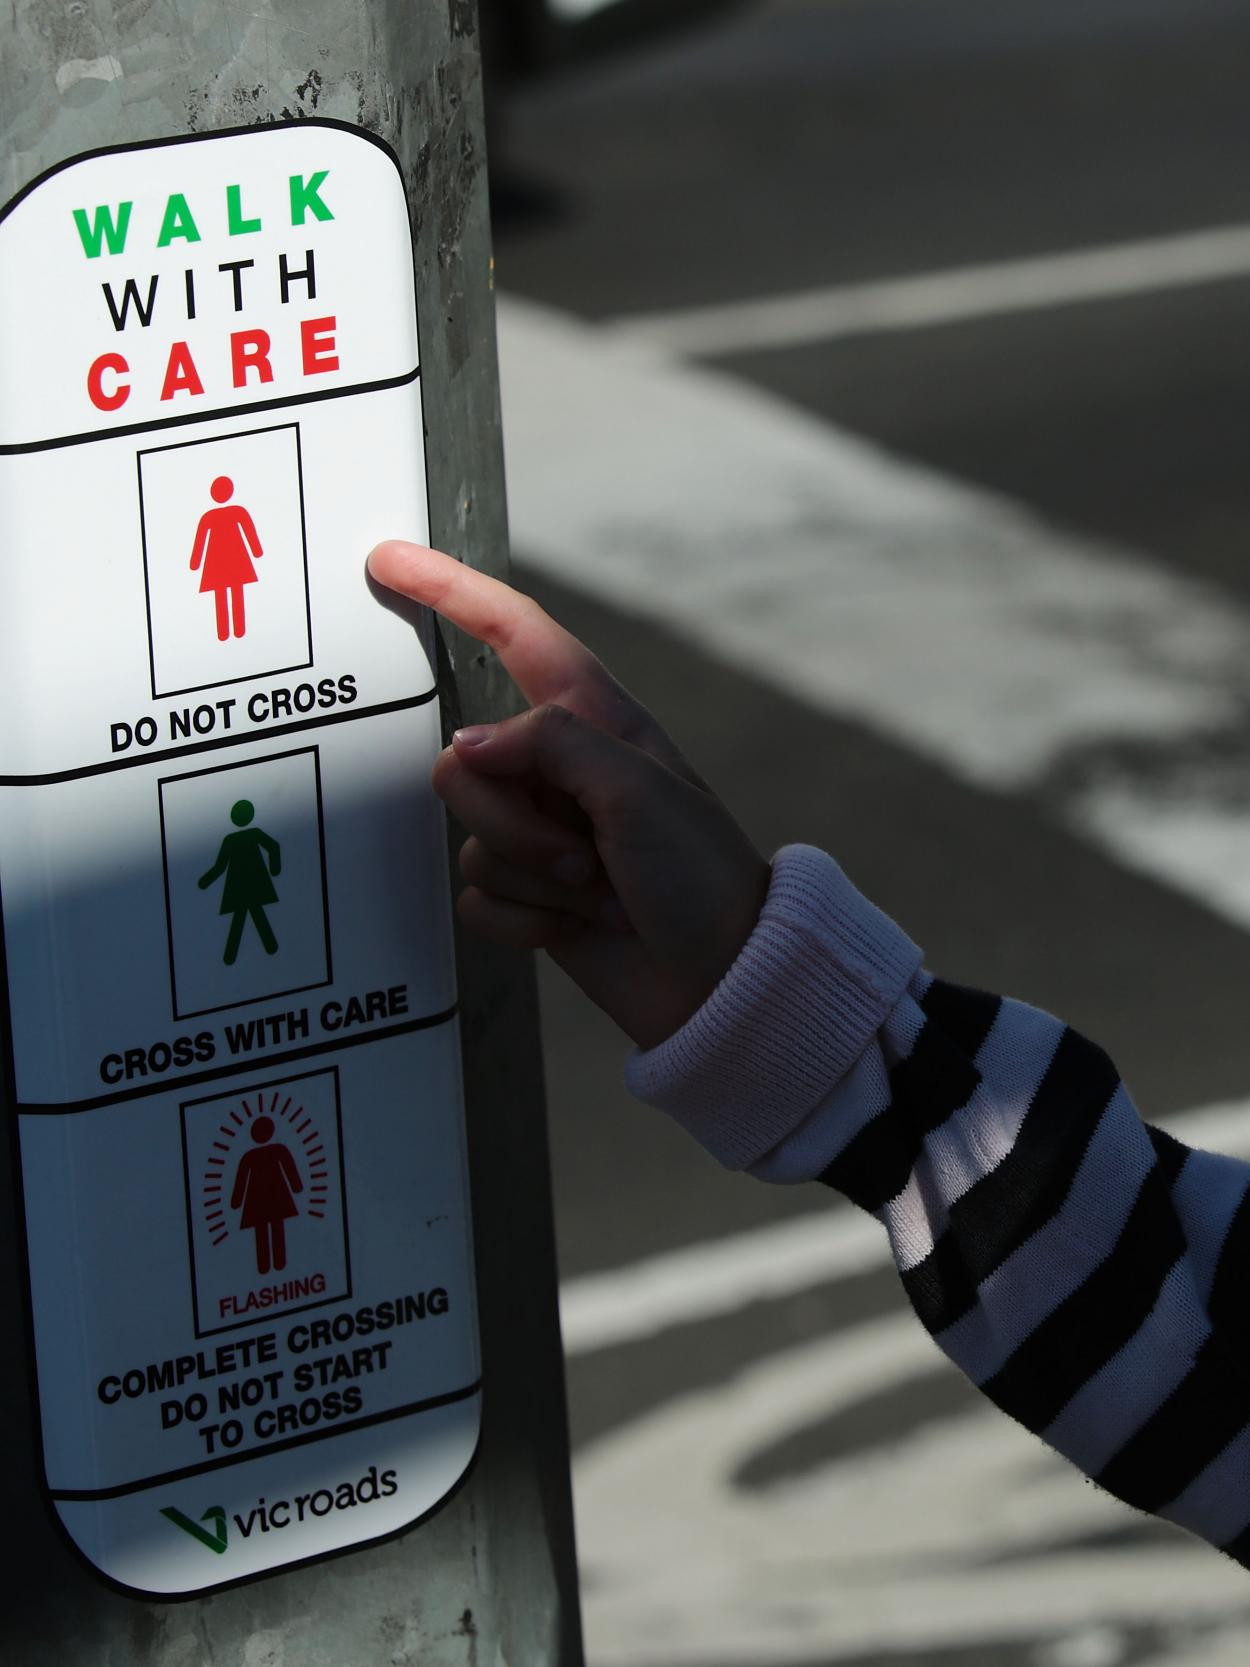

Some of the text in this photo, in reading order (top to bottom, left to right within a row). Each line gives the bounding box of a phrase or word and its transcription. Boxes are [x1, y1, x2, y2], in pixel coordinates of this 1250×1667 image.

[72, 171, 334, 259] WALK
[102, 250, 317, 331] WITH
[88, 316, 340, 411] CARE
[111, 675, 357, 752] DO NOT CROSS
[100, 985, 408, 1084] CROSS WITH CARE
[219, 1273, 326, 1318] FLASHING
[98, 1287, 449, 1404] COMPLETE CROSSING
[161, 1342, 392, 1429] DO NOT START
[200, 1387, 363, 1453] TO CROSS
